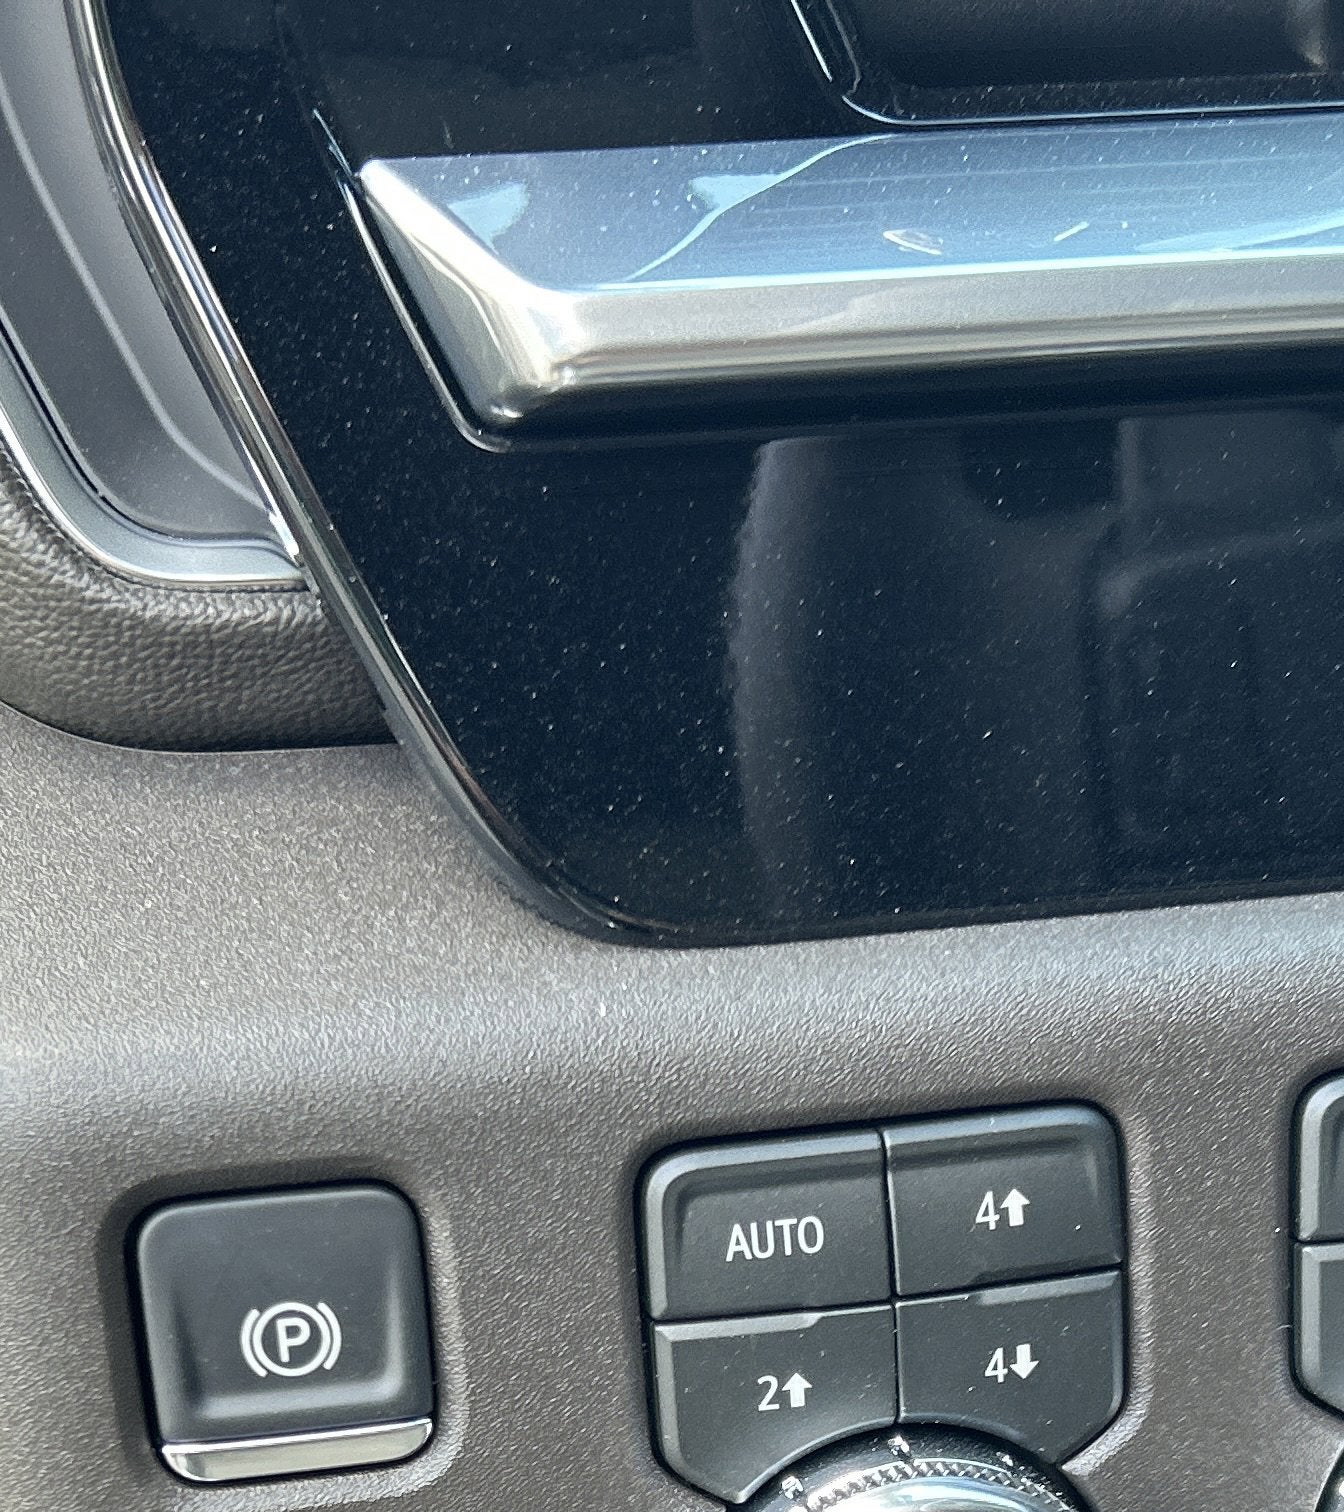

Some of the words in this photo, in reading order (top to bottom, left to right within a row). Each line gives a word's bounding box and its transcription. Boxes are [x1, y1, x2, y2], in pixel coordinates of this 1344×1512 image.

[975, 1191, 1000, 1231] 4
[724, 1215, 825, 1262] AUTO
[275, 1316, 312, 1363] P
[984, 1346, 1008, 1384] 4
[756, 1374, 780, 1412] 2
